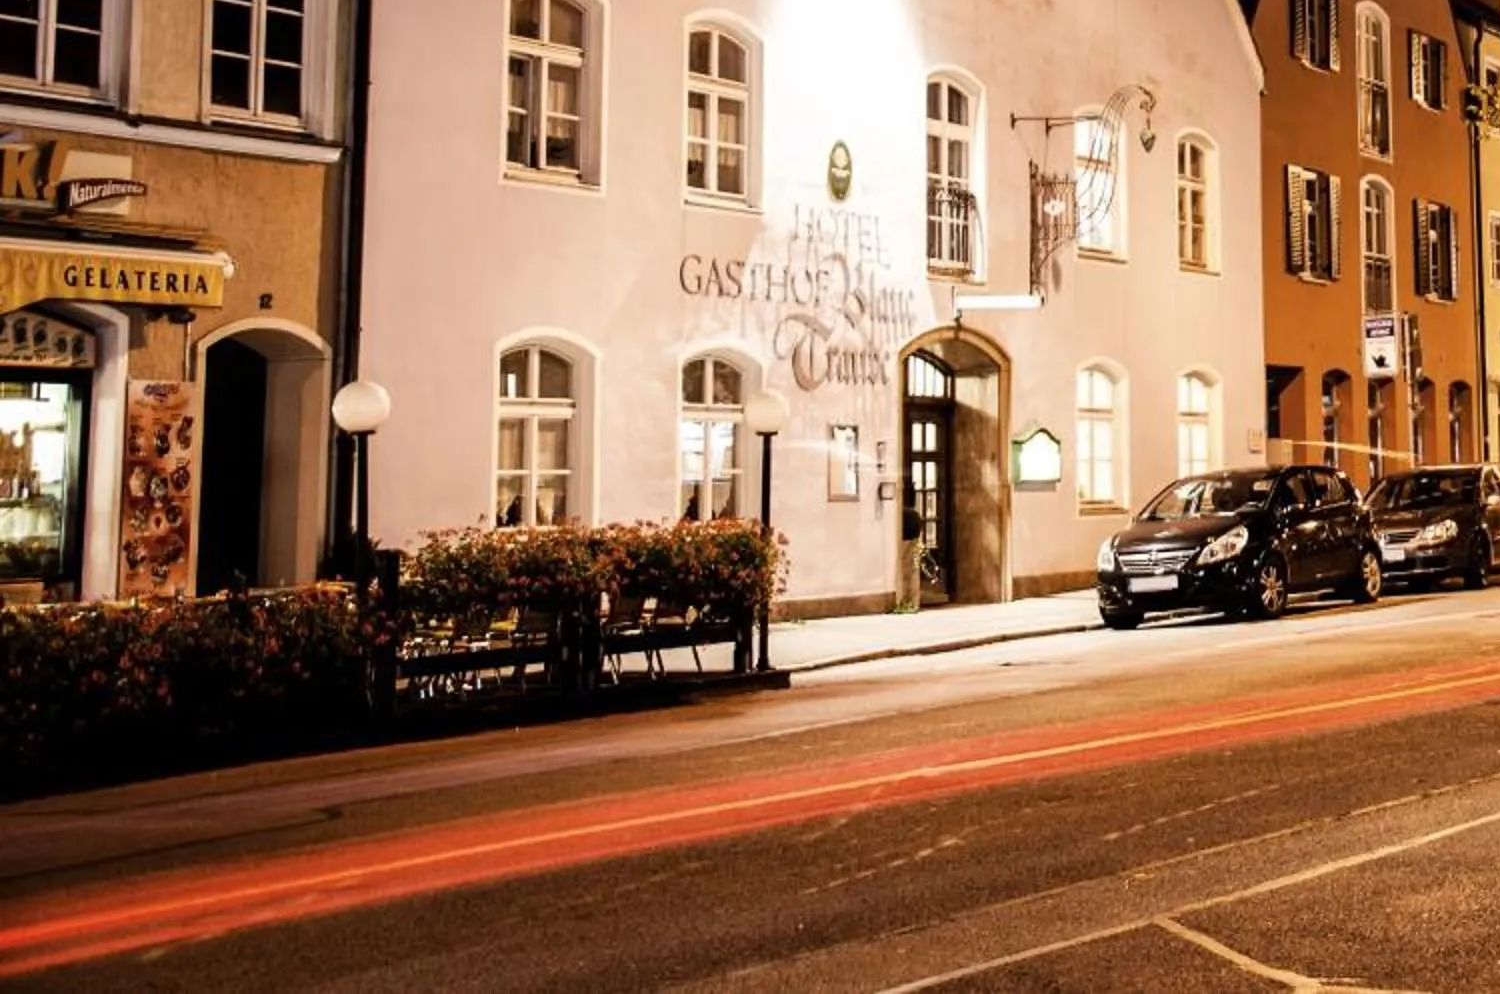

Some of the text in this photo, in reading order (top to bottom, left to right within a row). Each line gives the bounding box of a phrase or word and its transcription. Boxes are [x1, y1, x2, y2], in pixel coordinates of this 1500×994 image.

[792, 203, 890, 260] HOTEL
[64, 265, 208, 294] GELATERIA
[680, 254, 829, 307] GASTHOF
